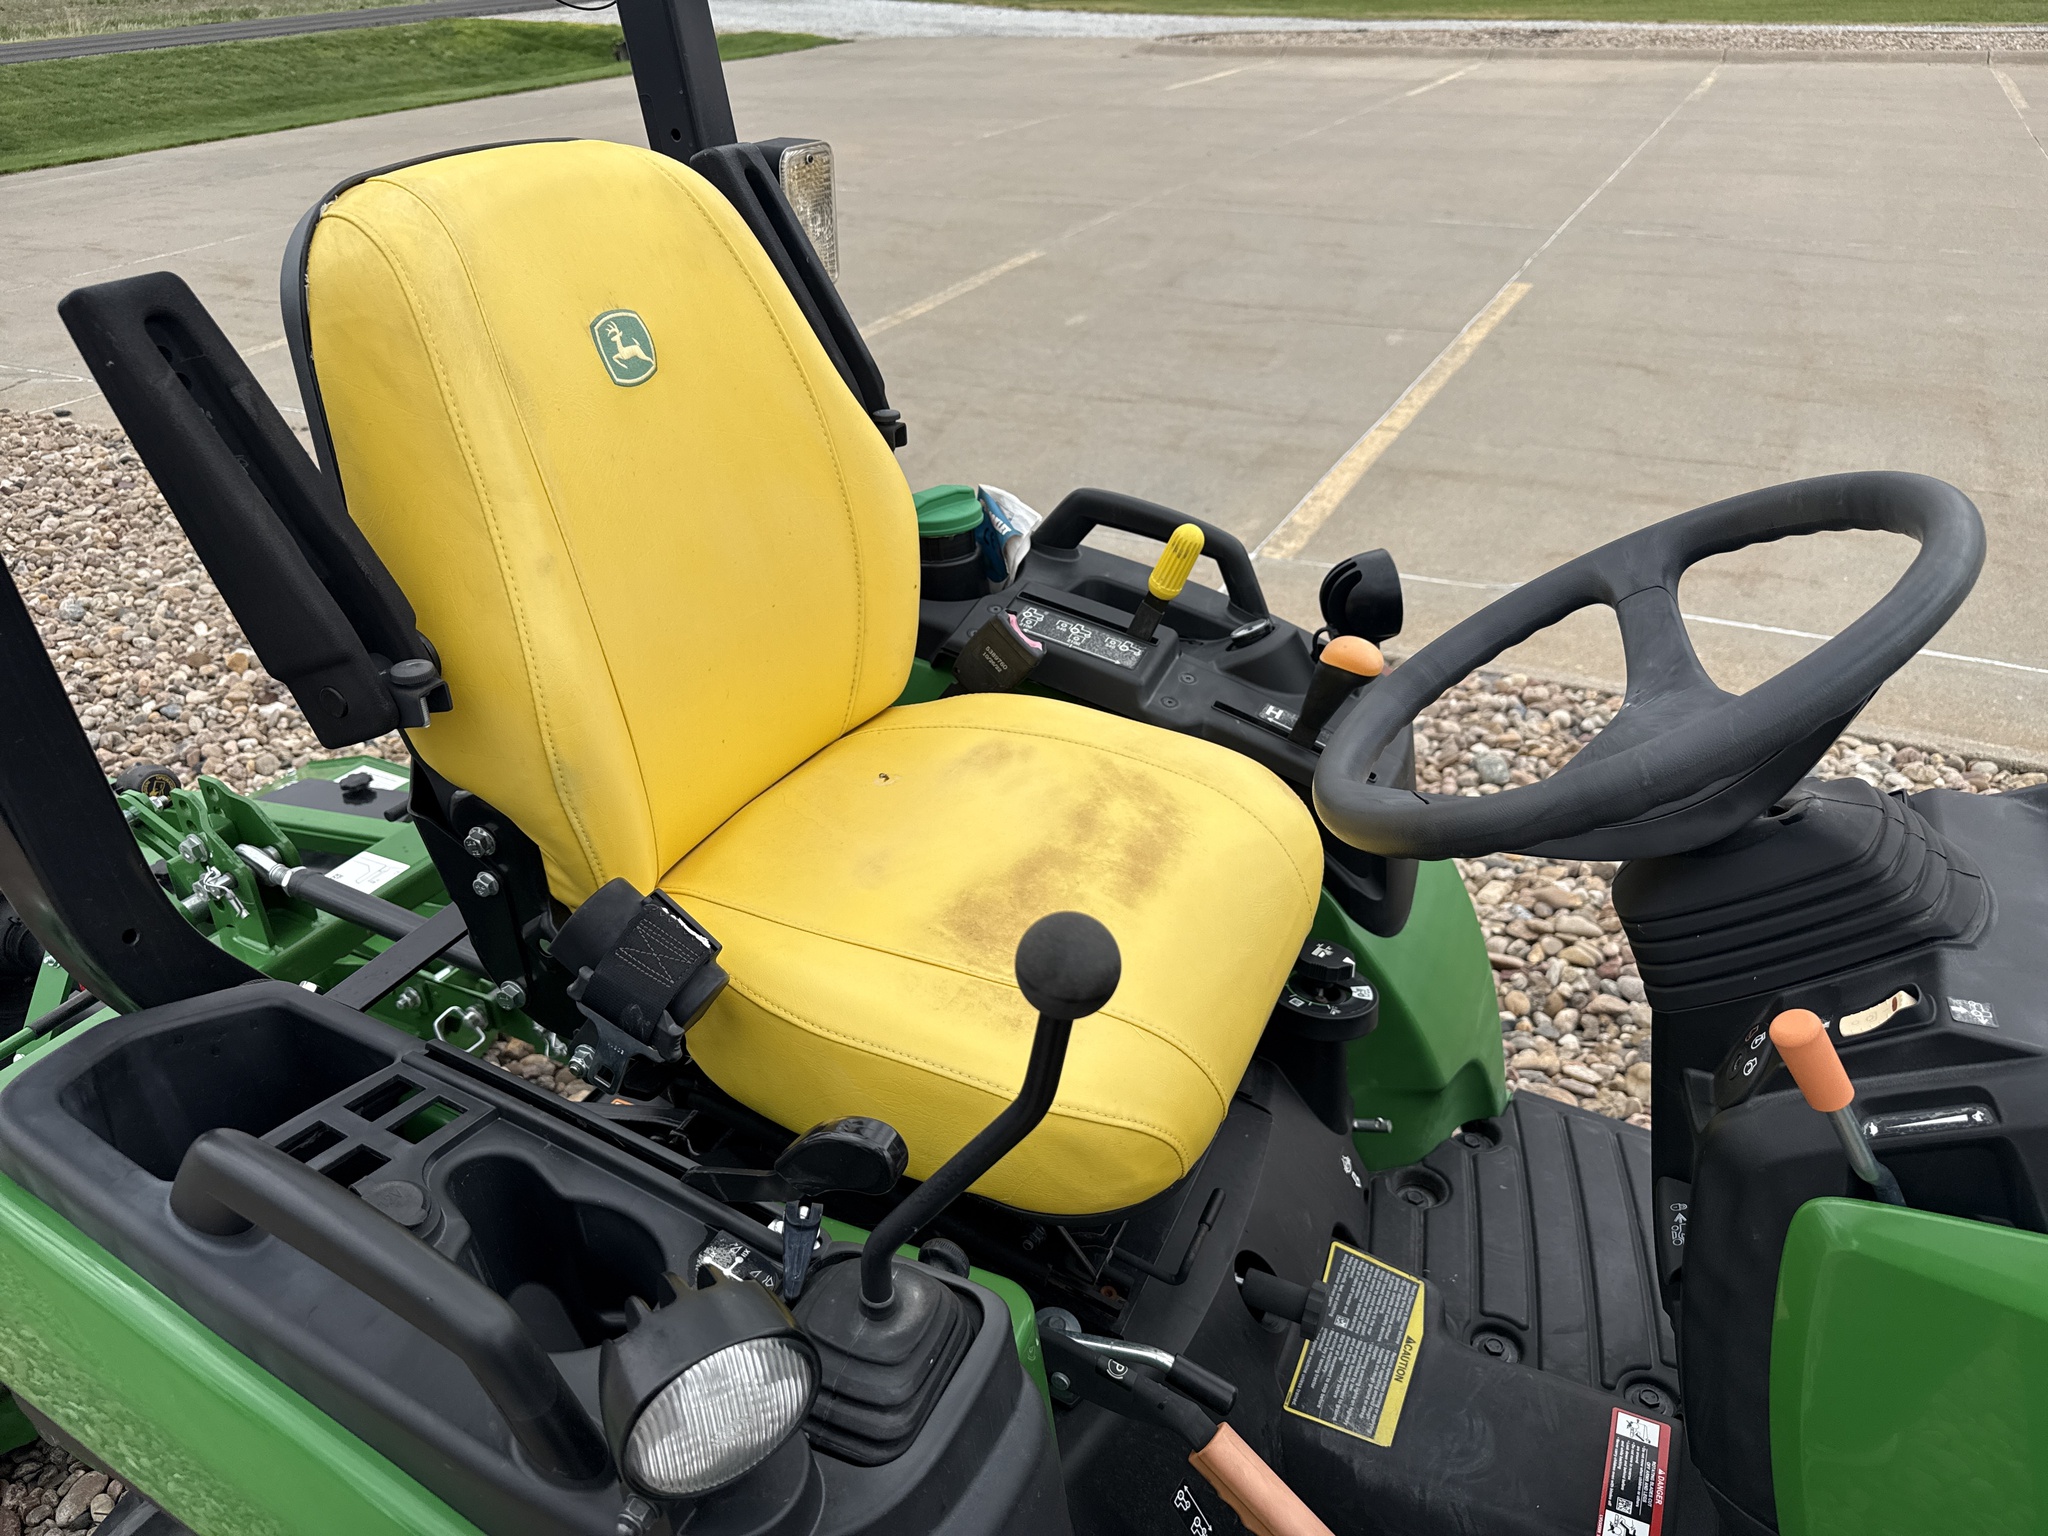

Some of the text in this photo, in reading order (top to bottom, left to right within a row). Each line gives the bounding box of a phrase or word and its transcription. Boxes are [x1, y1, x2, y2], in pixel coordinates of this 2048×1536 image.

[1265, 705, 1283, 720] H
[1394, 1344, 1413, 1383] CAUTION
[1655, 1472, 1666, 1506] DANGER
